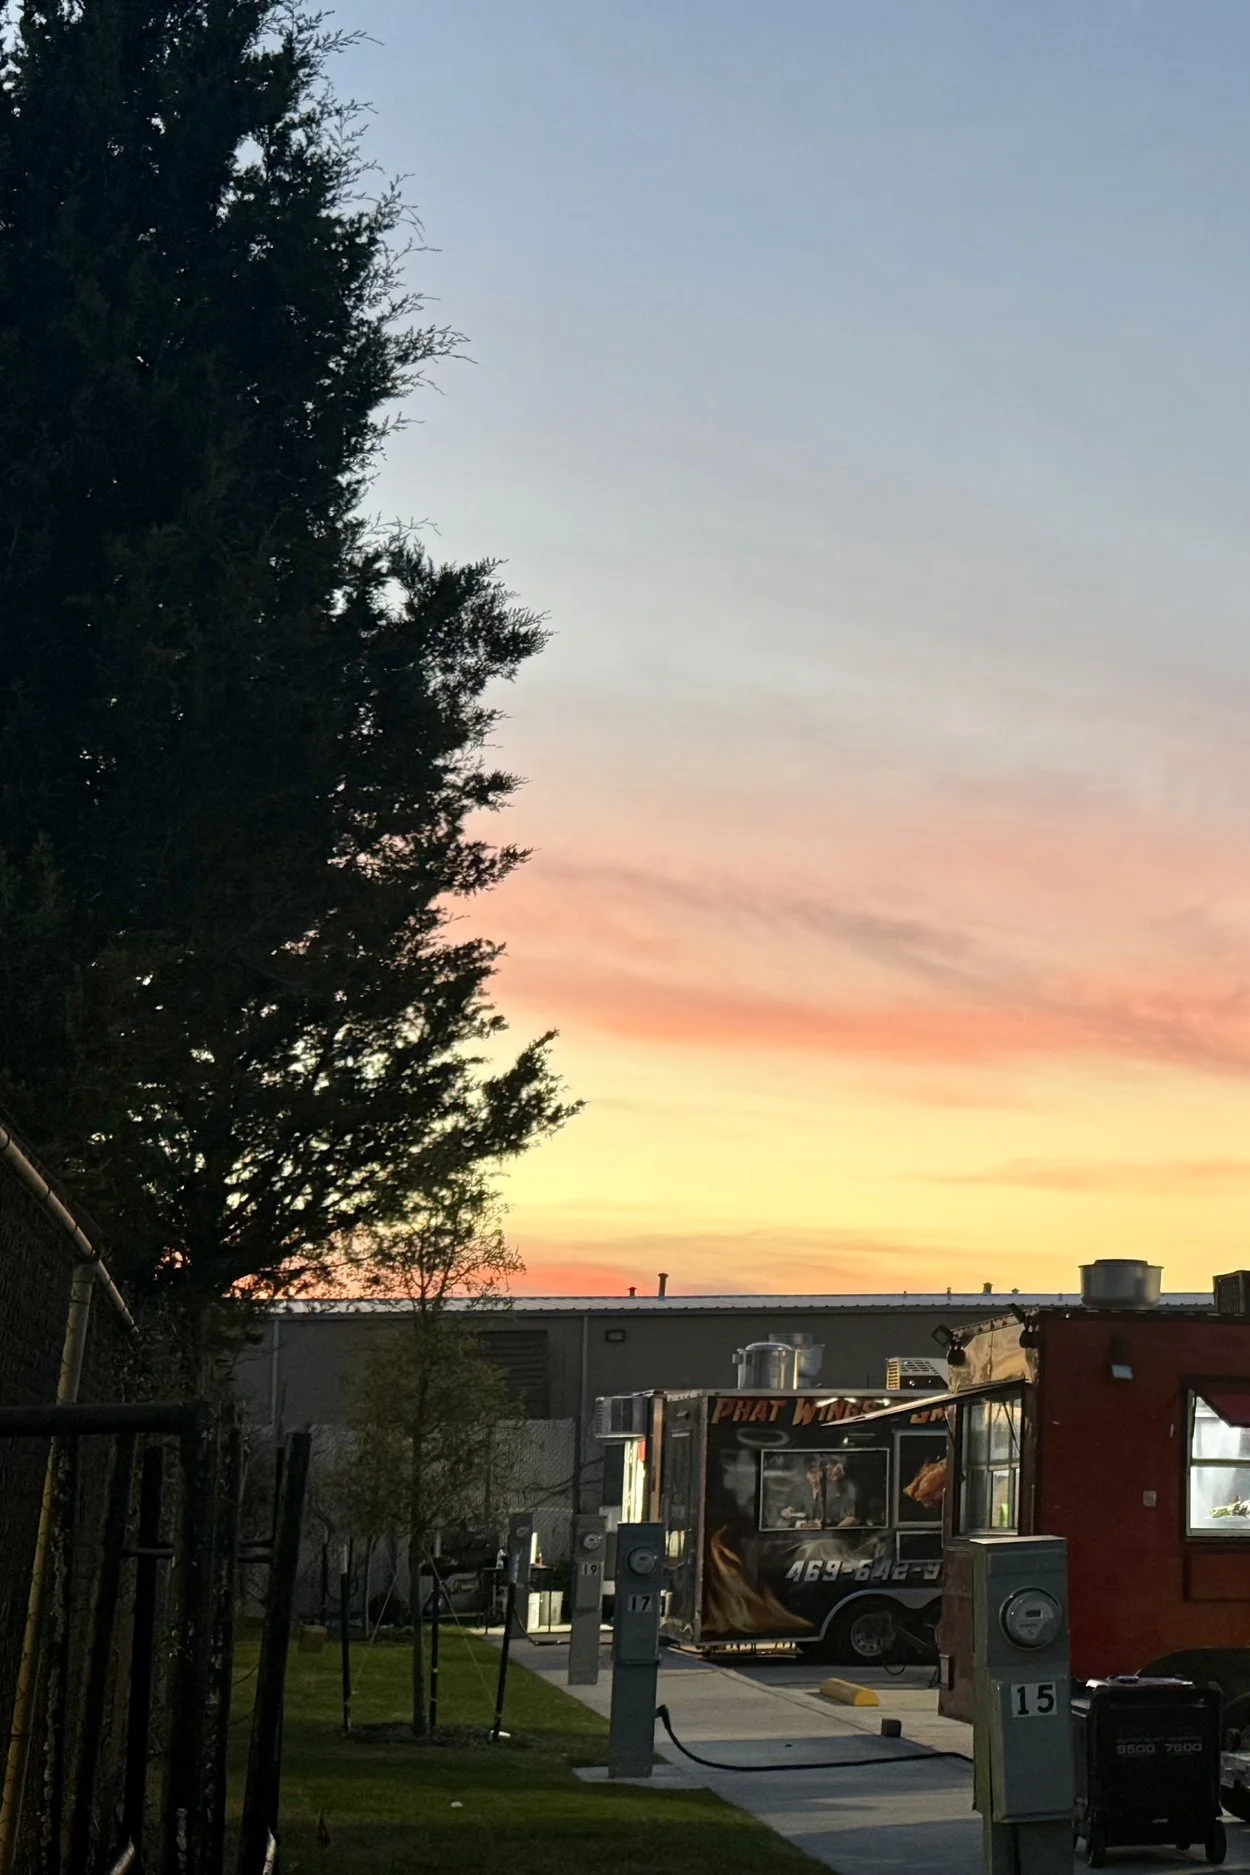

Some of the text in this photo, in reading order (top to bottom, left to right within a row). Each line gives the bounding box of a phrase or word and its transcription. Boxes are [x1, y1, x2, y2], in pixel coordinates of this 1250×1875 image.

[711, 1397, 786, 1424] PHAT
[584, 1564, 597, 1576] 19
[632, 1596, 650, 1611] 17
[1017, 1684, 1054, 1715] 15
